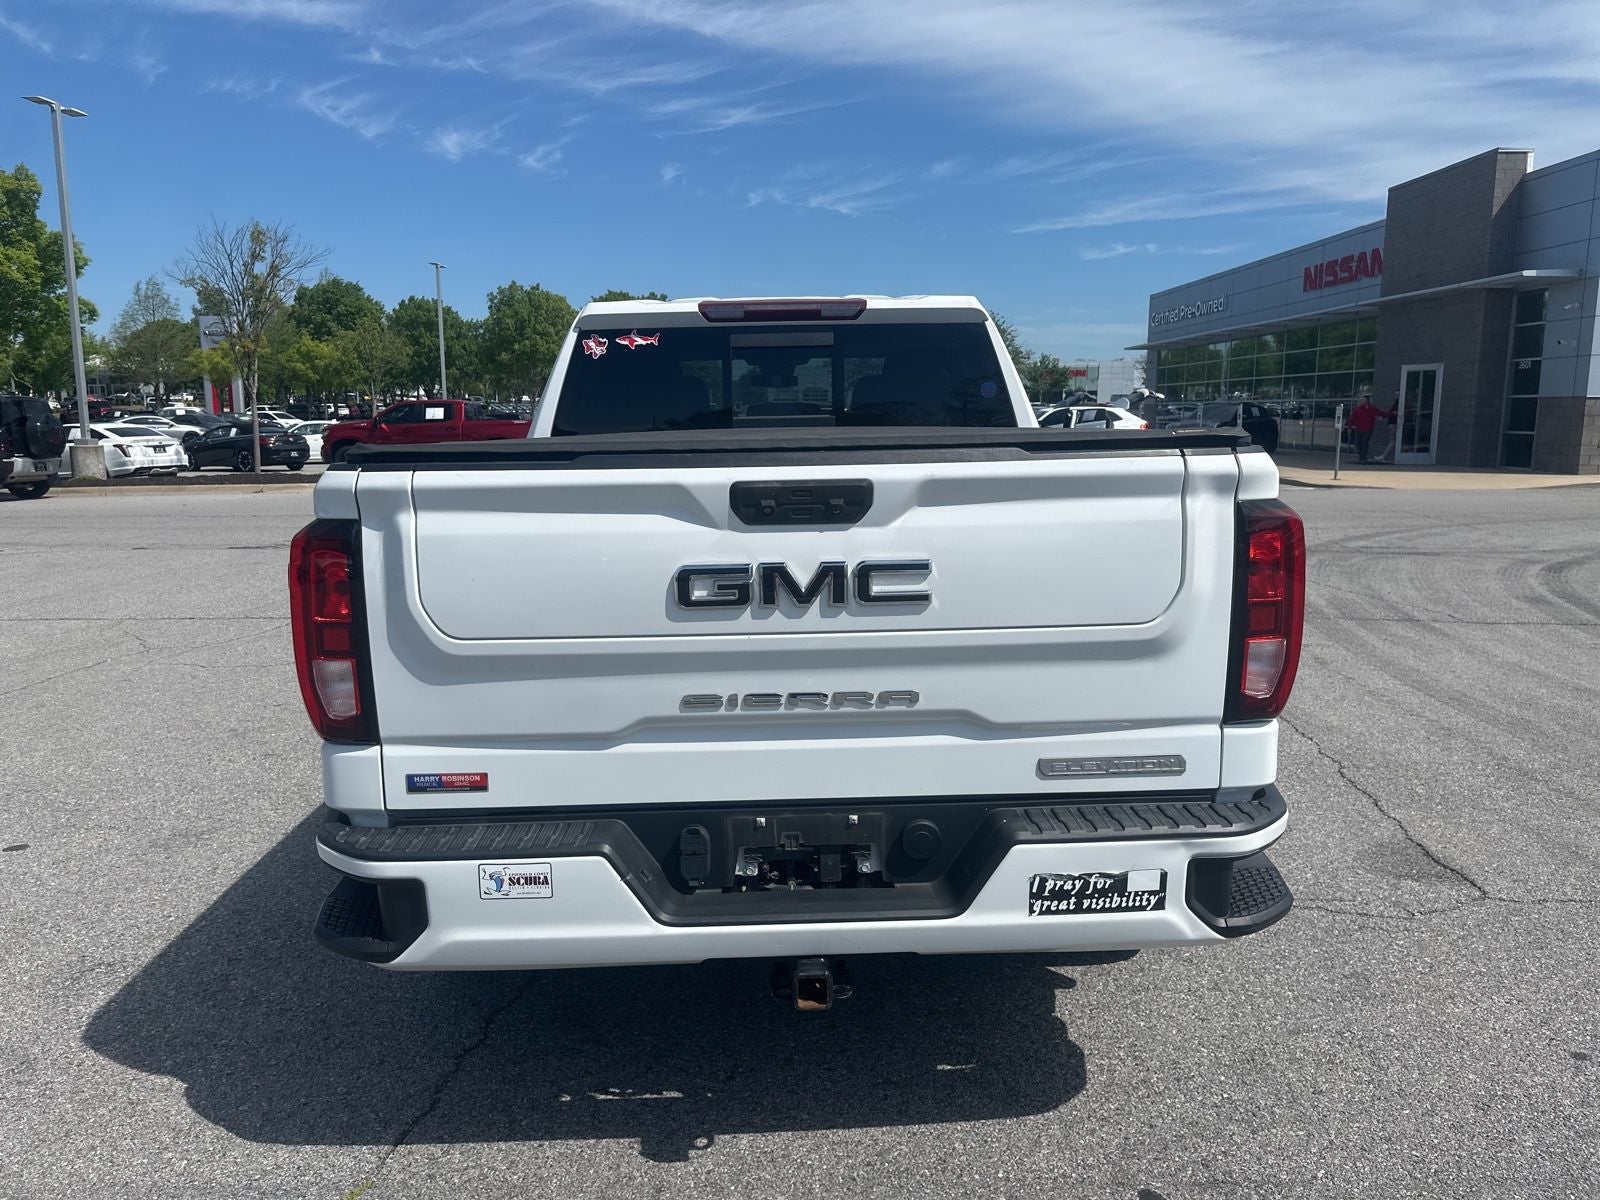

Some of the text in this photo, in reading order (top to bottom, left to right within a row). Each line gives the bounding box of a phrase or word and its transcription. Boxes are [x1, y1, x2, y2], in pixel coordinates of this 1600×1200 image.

[1151, 295, 1225, 326] Certified Pre-Owned
[675, 559, 932, 608] GMC
[682, 690, 920, 711] SIERRA
[1050, 758, 1178, 771] ELEVATION
[413, 775, 440, 783] HARRY
[508, 876, 550, 887] SCUBA
[1032, 873, 1114, 896] I pray for
[1030, 891, 1165, 916] "great visibility"
